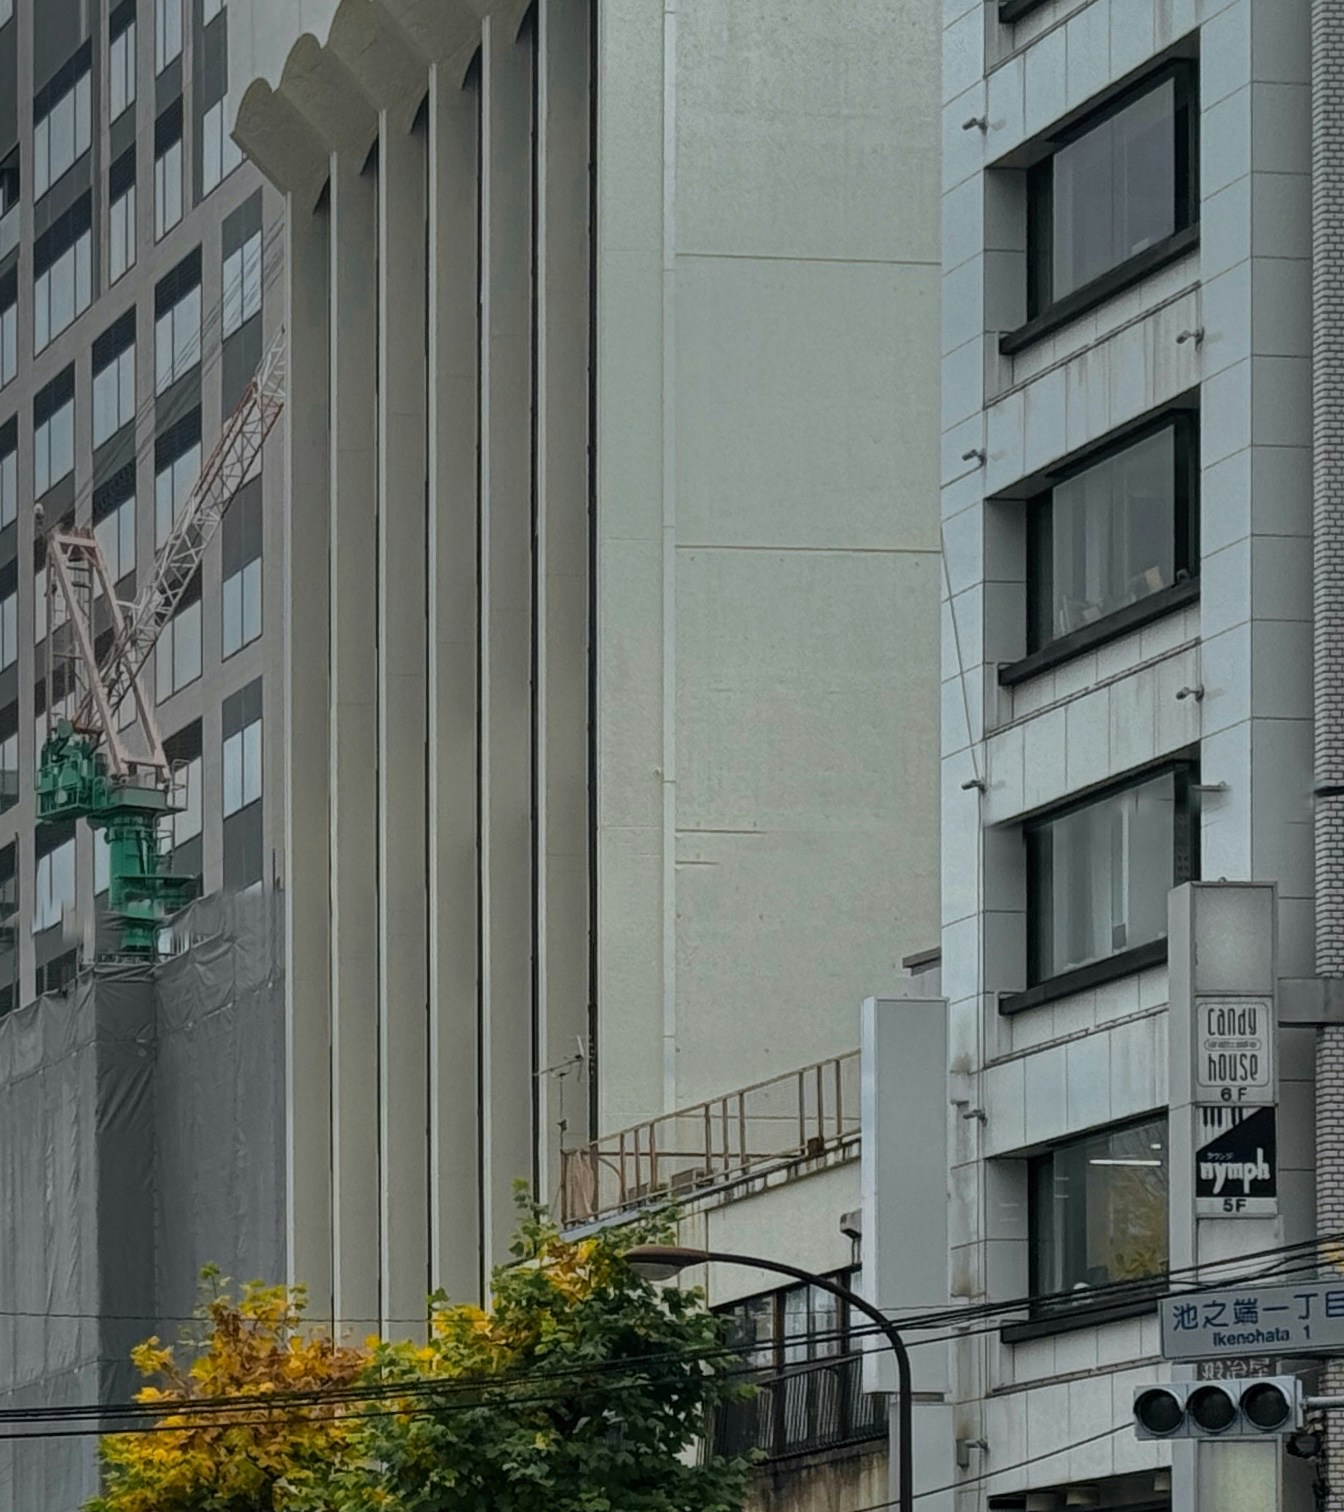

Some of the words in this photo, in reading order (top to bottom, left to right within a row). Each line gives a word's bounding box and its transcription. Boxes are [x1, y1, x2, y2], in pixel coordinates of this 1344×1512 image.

[1208, 1008, 1257, 1036] candy
[1208, 1053, 1258, 1082] house
[1200, 1147, 1271, 1195] nymph
[1223, 1199, 1247, 1212] 5F
[1214, 1328, 1290, 1347] Ikenohata
[1303, 1325, 1311, 1340] 1
